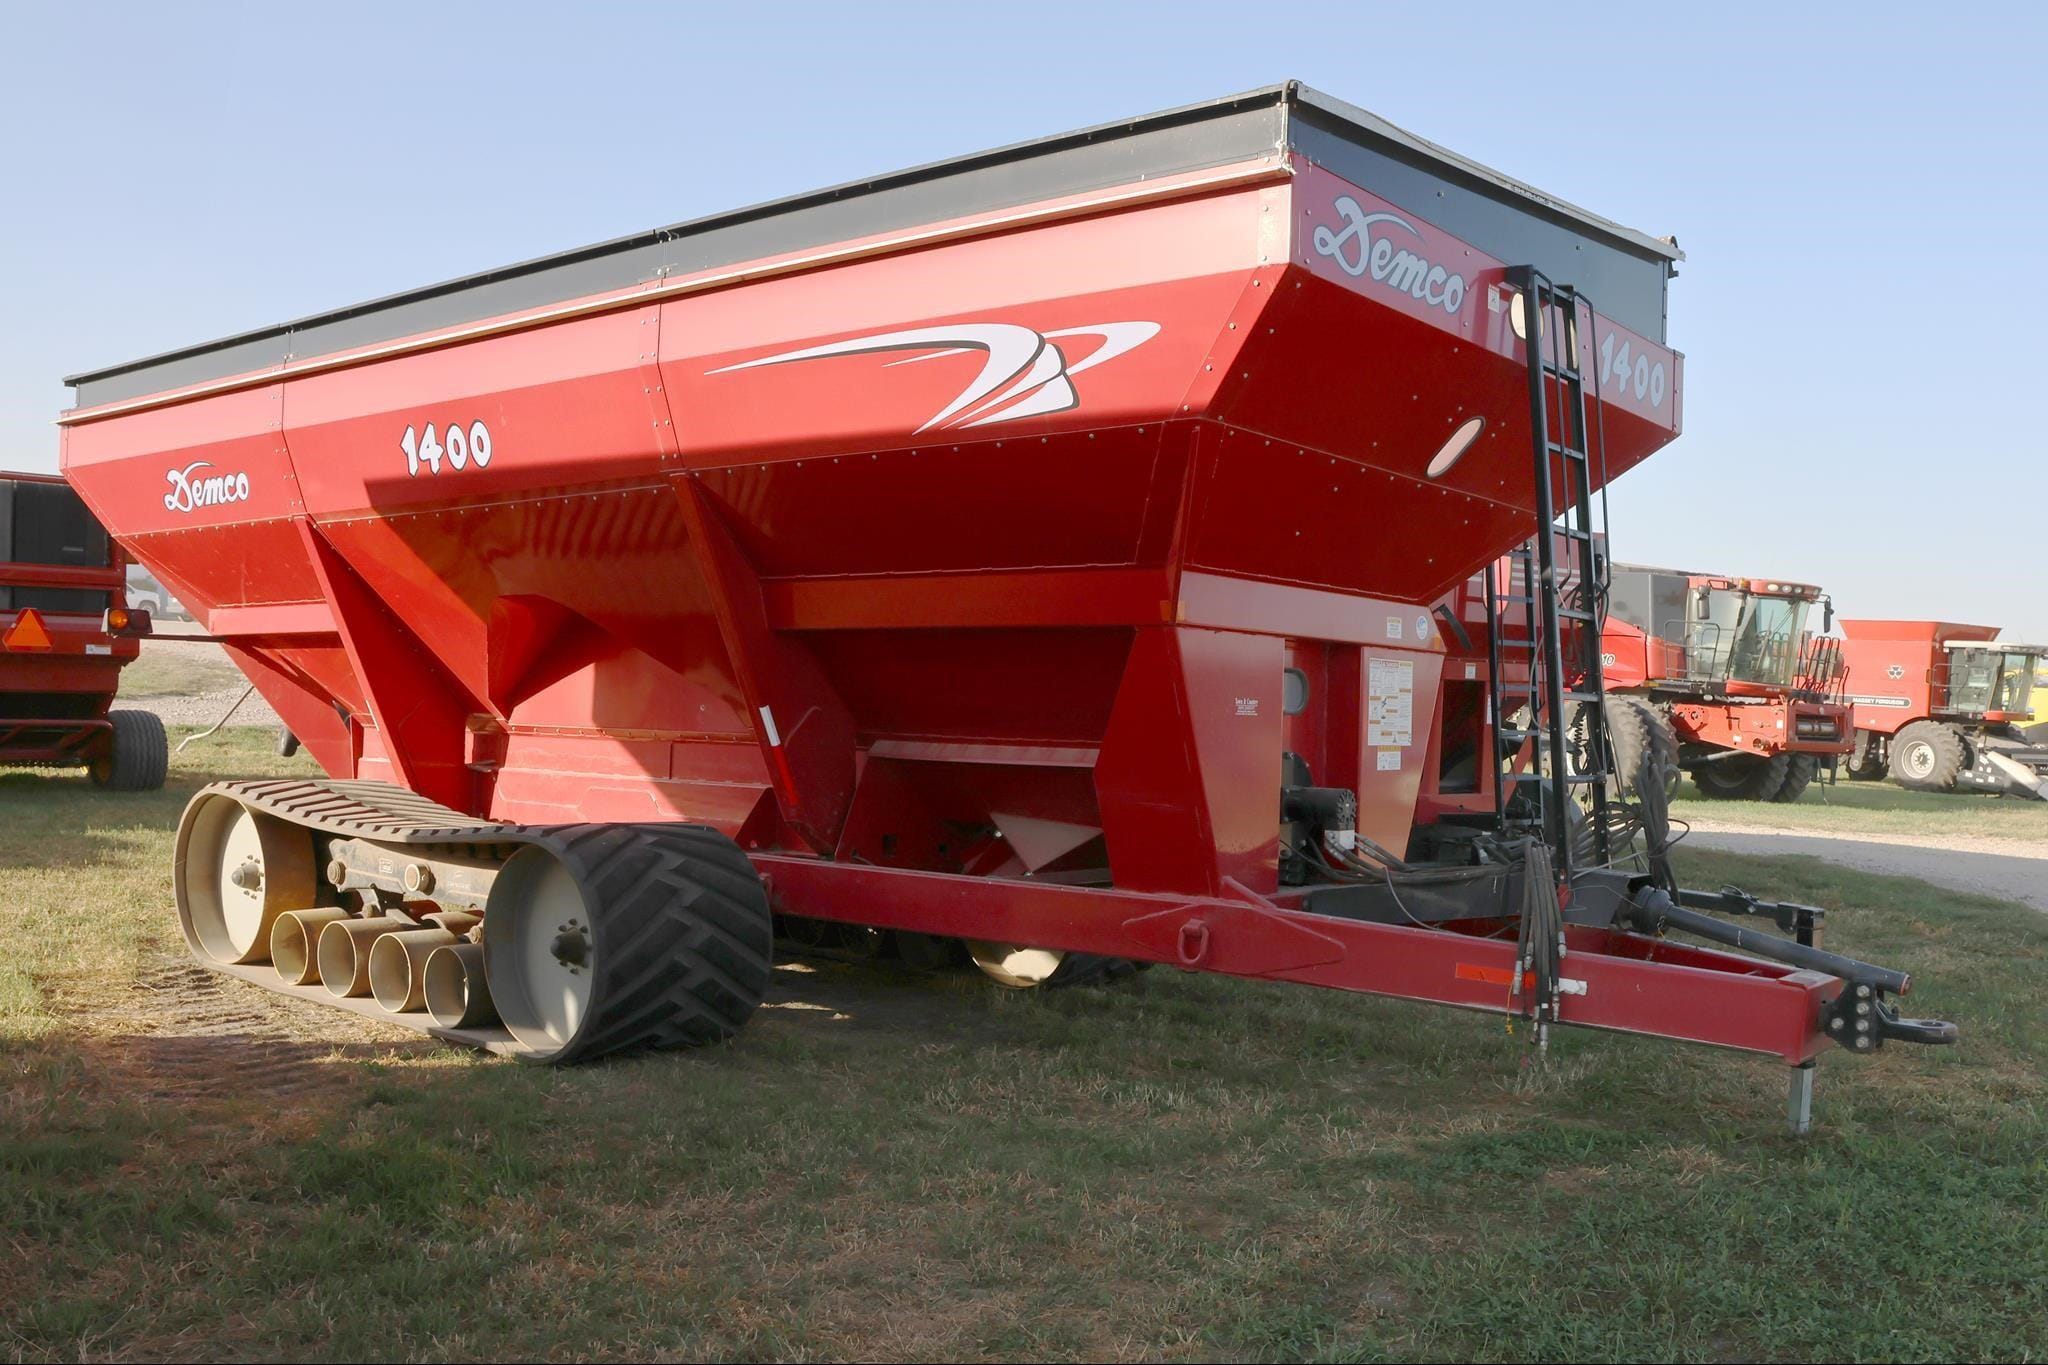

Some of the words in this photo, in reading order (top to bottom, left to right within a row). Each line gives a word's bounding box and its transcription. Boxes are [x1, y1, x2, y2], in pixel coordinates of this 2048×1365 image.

[1313, 195, 1465, 314] Demco
[1600, 331, 1665, 408] 1400
[400, 419, 493, 477] 1400
[164, 461, 249, 513] Demco
